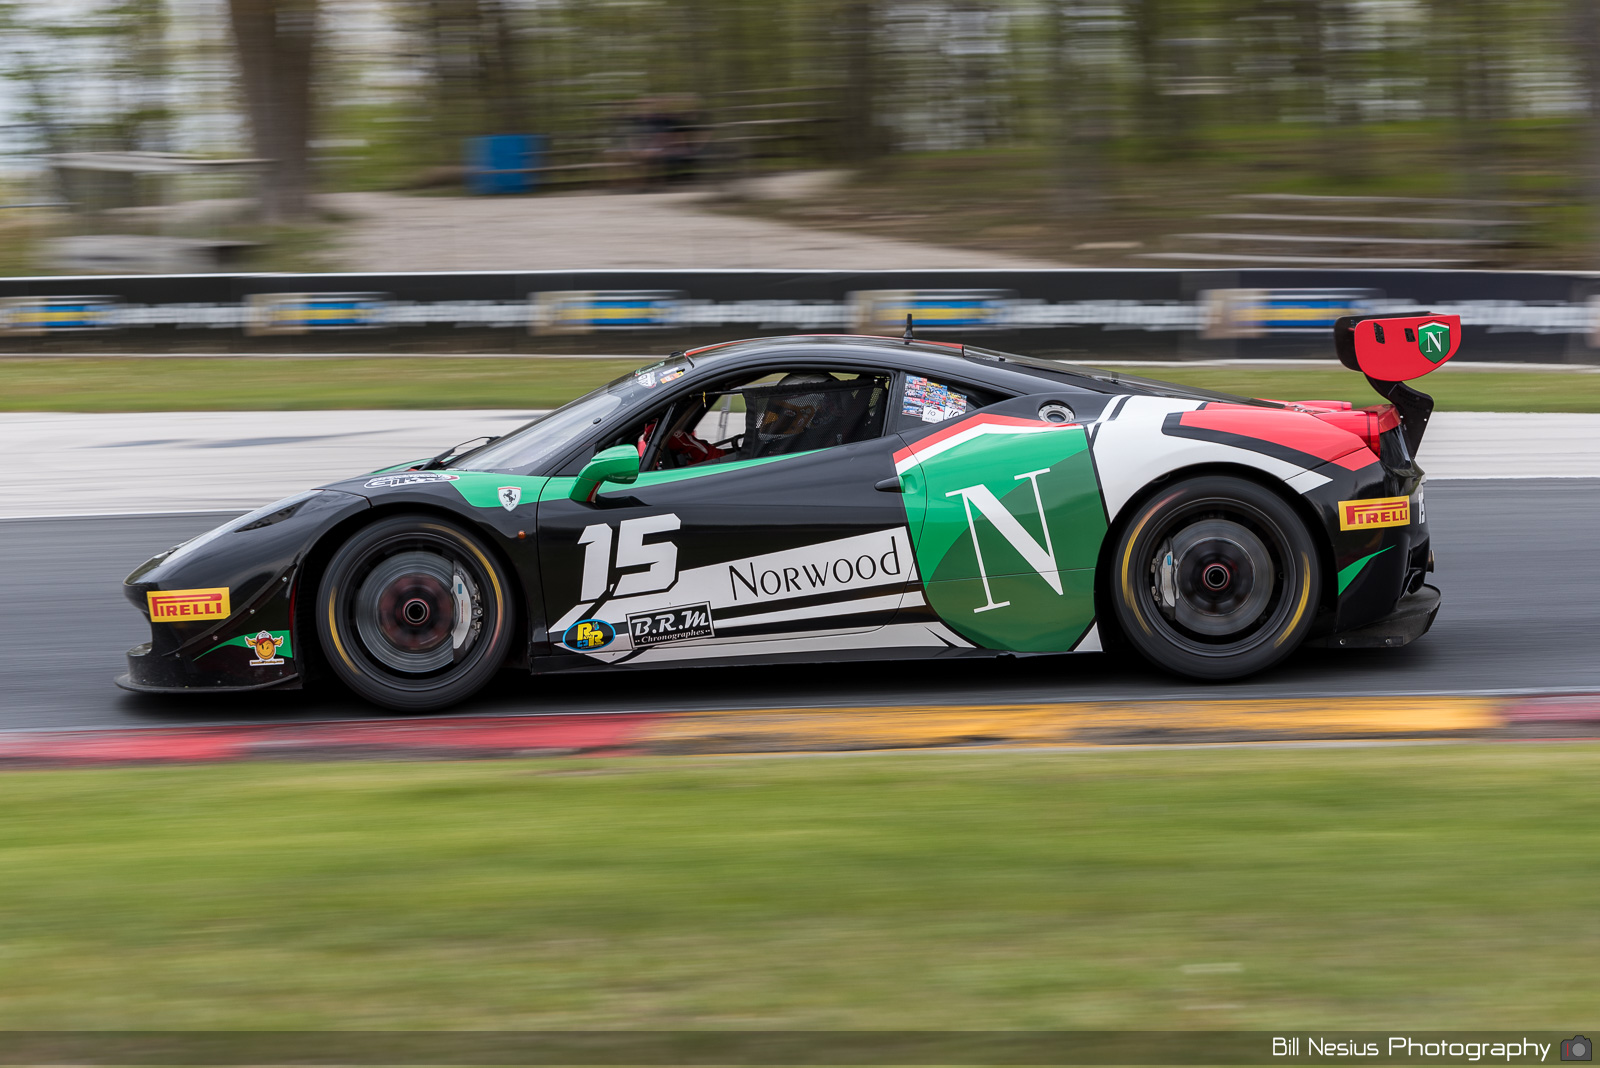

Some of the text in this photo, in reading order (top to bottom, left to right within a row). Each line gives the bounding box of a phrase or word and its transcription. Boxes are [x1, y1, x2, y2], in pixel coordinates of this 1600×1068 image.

[1425, 331, 1443, 353] N
[1345, 500, 1408, 526] PIRELLI
[945, 467, 1064, 614] N
[577, 512, 682, 602] 15
[151, 593, 223, 618] PIRELLI
[641, 629, 705, 644] Chronographes
